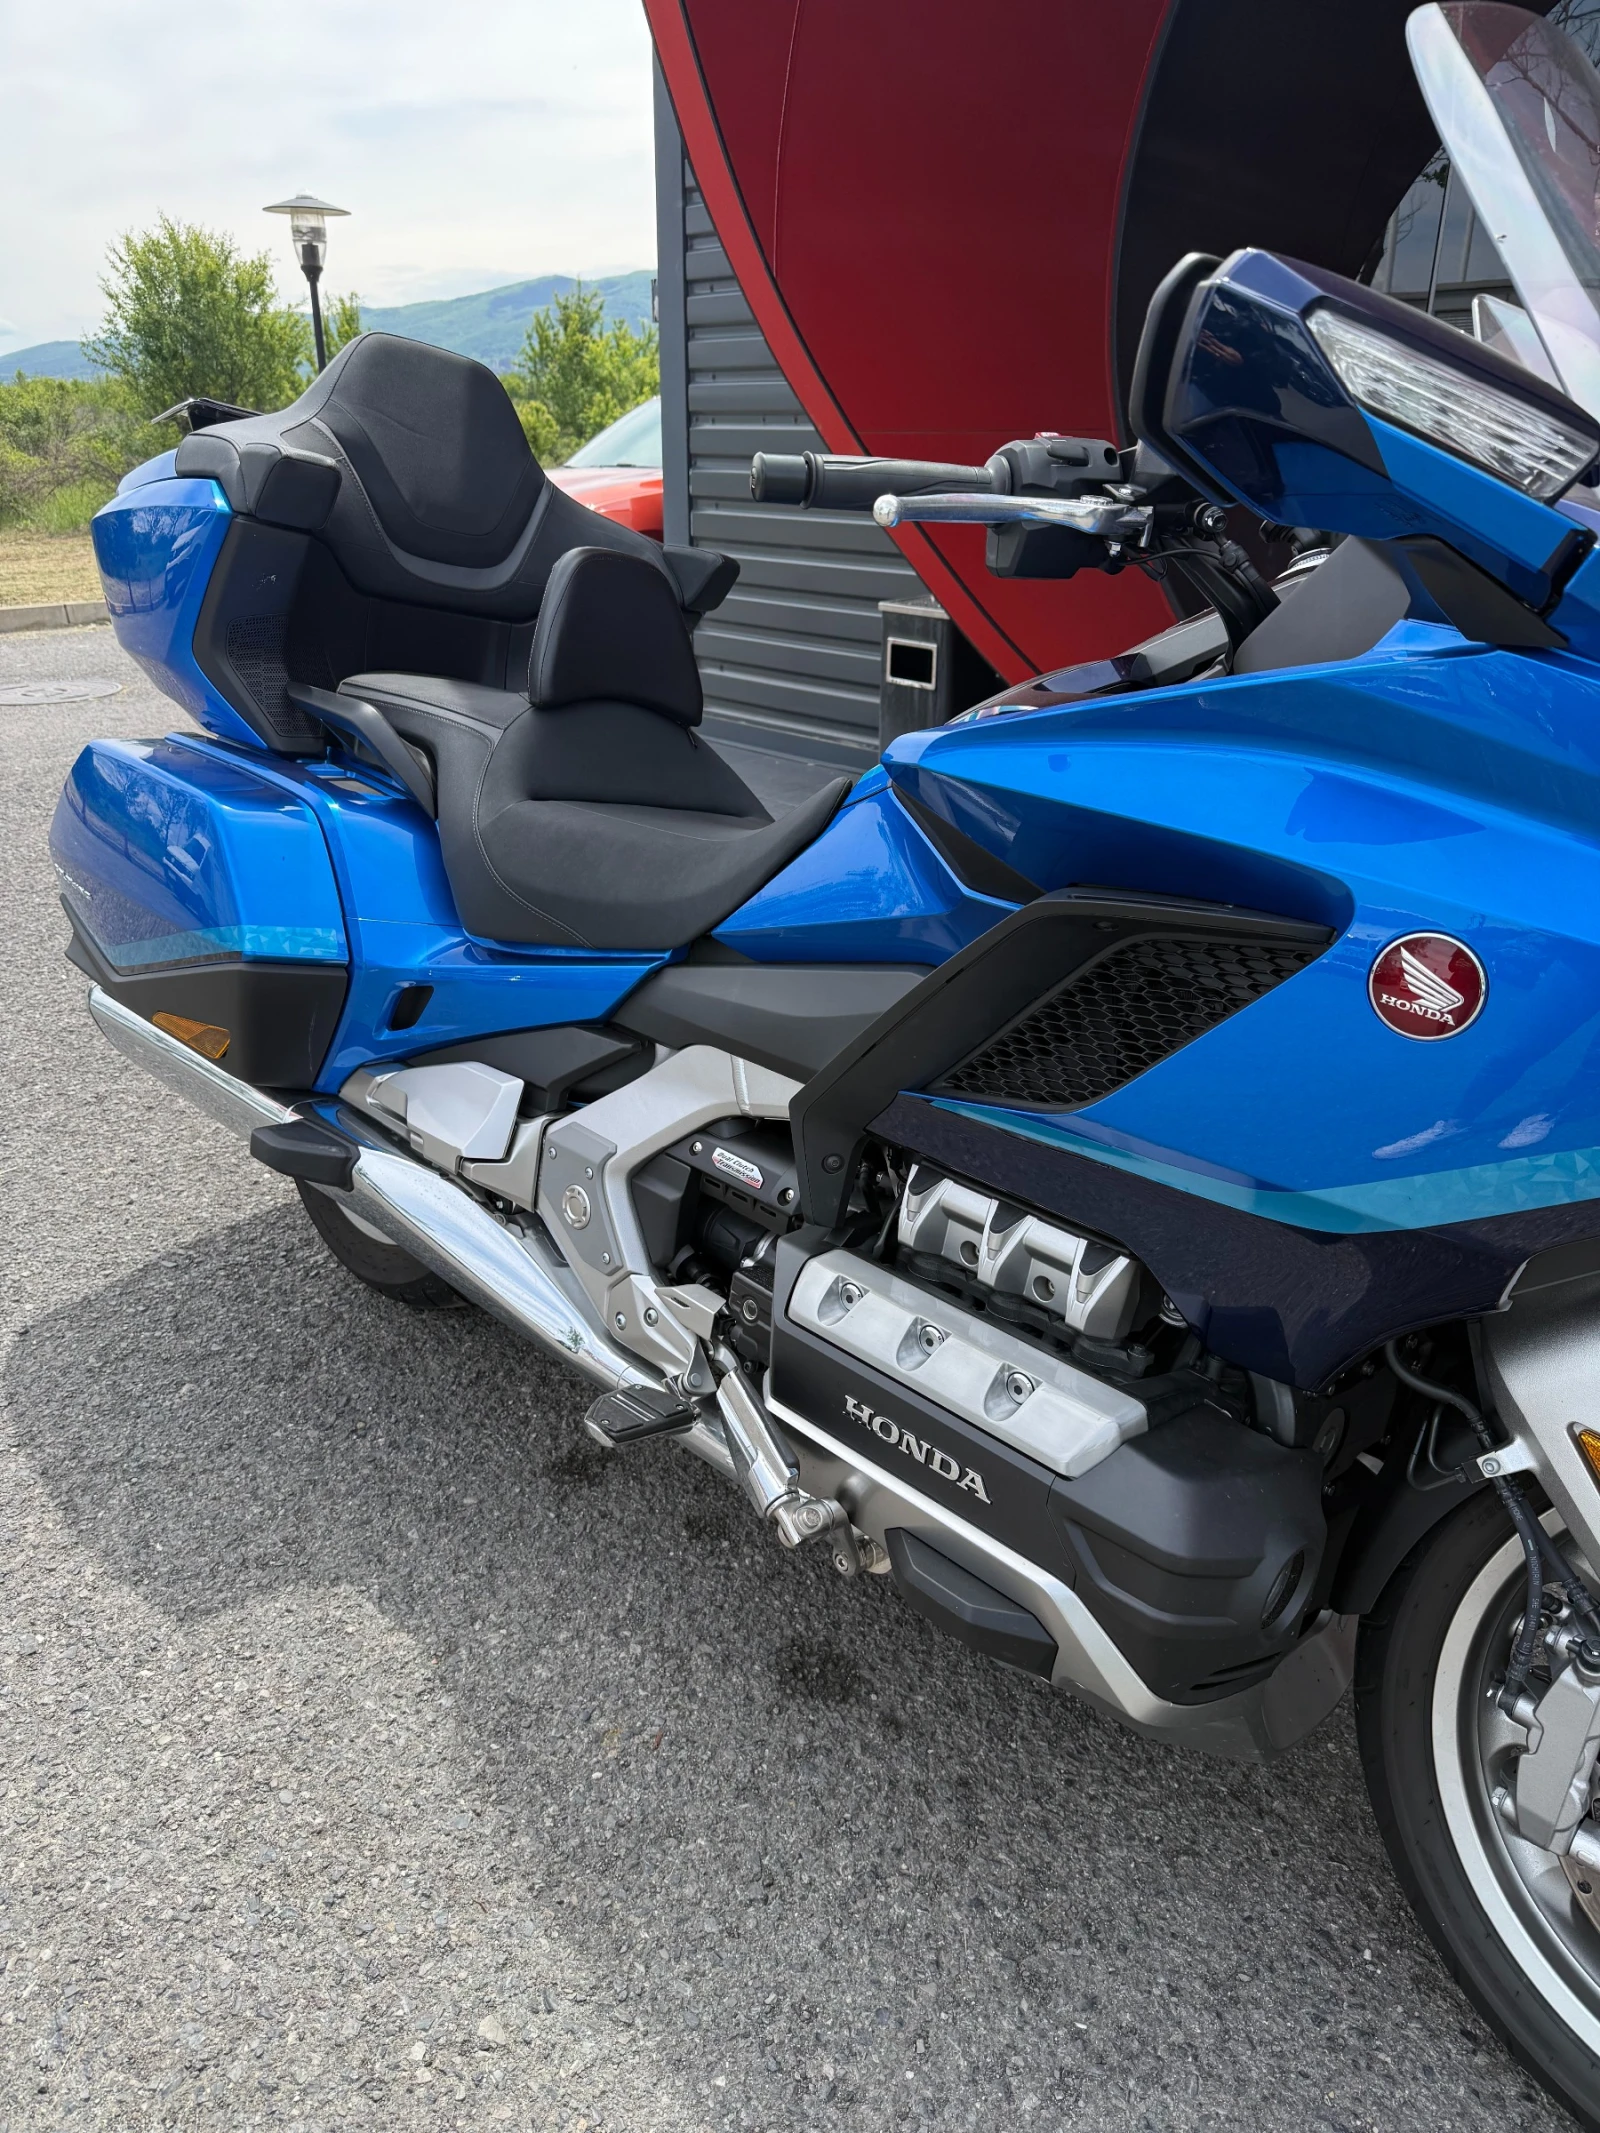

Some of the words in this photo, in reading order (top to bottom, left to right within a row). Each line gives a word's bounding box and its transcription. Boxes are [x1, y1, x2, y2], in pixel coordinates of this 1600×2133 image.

[1380, 993, 1455, 1026] HONDA
[717, 1152, 735, 1163] Dual
[733, 1160, 755, 1173] Clutch
[717, 1159, 761, 1184] Transmission
[843, 1394, 992, 1505] HONDA
